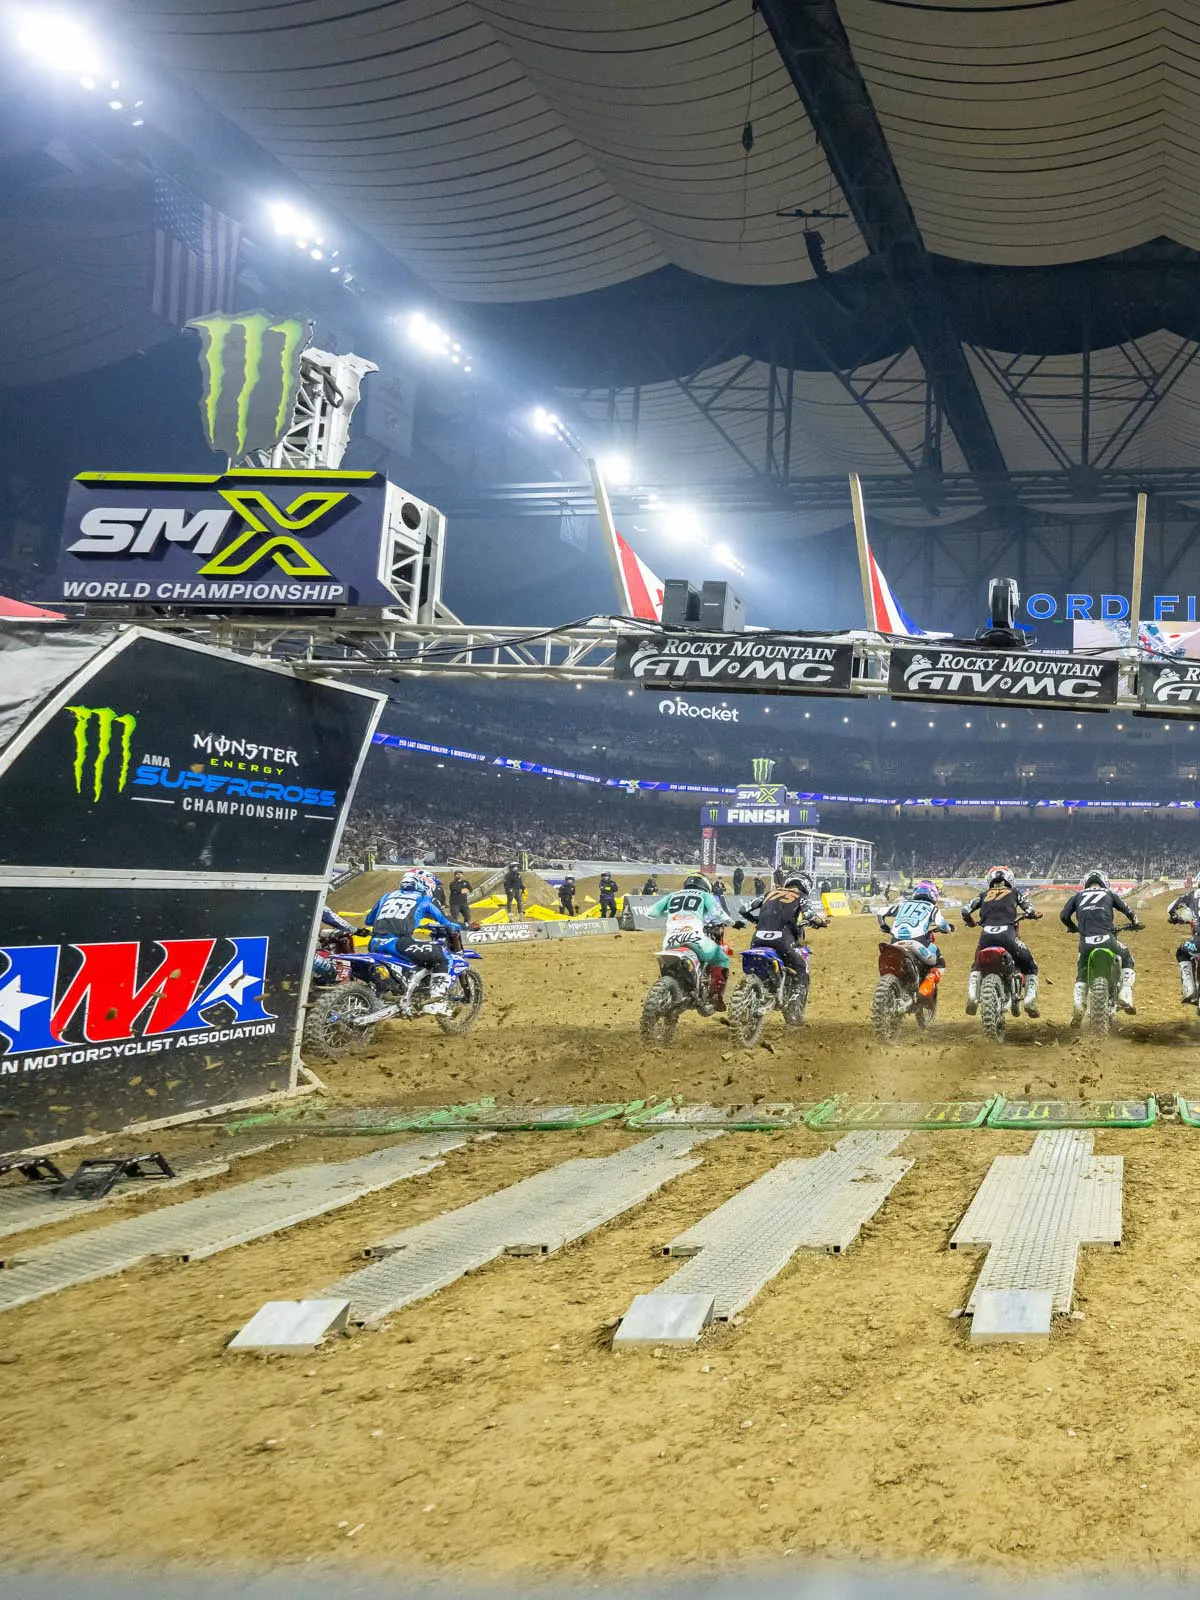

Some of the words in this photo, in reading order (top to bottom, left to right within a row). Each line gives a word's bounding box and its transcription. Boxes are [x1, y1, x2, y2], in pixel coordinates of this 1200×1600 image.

[66, 490, 349, 576] SMX
[63, 581, 150, 598] WORLD
[156, 581, 344, 600] CHAMPIONSHIP
[662, 639, 728, 656] ROCKY
[731, 641, 837, 661] MOUNTAIN
[936, 653, 999, 671] ROCKY
[1002, 657, 1103, 677] MOUNTAIN
[676, 701, 739, 723] Rocket
[193, 734, 299, 766] MONSTER
[142, 754, 171, 768] AMA
[210, 758, 285, 775] ENERGY
[132, 766, 336, 807] SUPERCROSS
[737, 788, 779, 803] SMX
[182, 797, 298, 820] CHAMPIONSHIP
[727, 809, 790, 823] FINISH
[669, 896, 702, 914] 90
[1079, 891, 1107, 906] 77
[377, 899, 417, 920] 268
[24, 1038, 173, 1071] MOTORCYCLIST
[176, 1024, 276, 1048] ASSOCIATION
